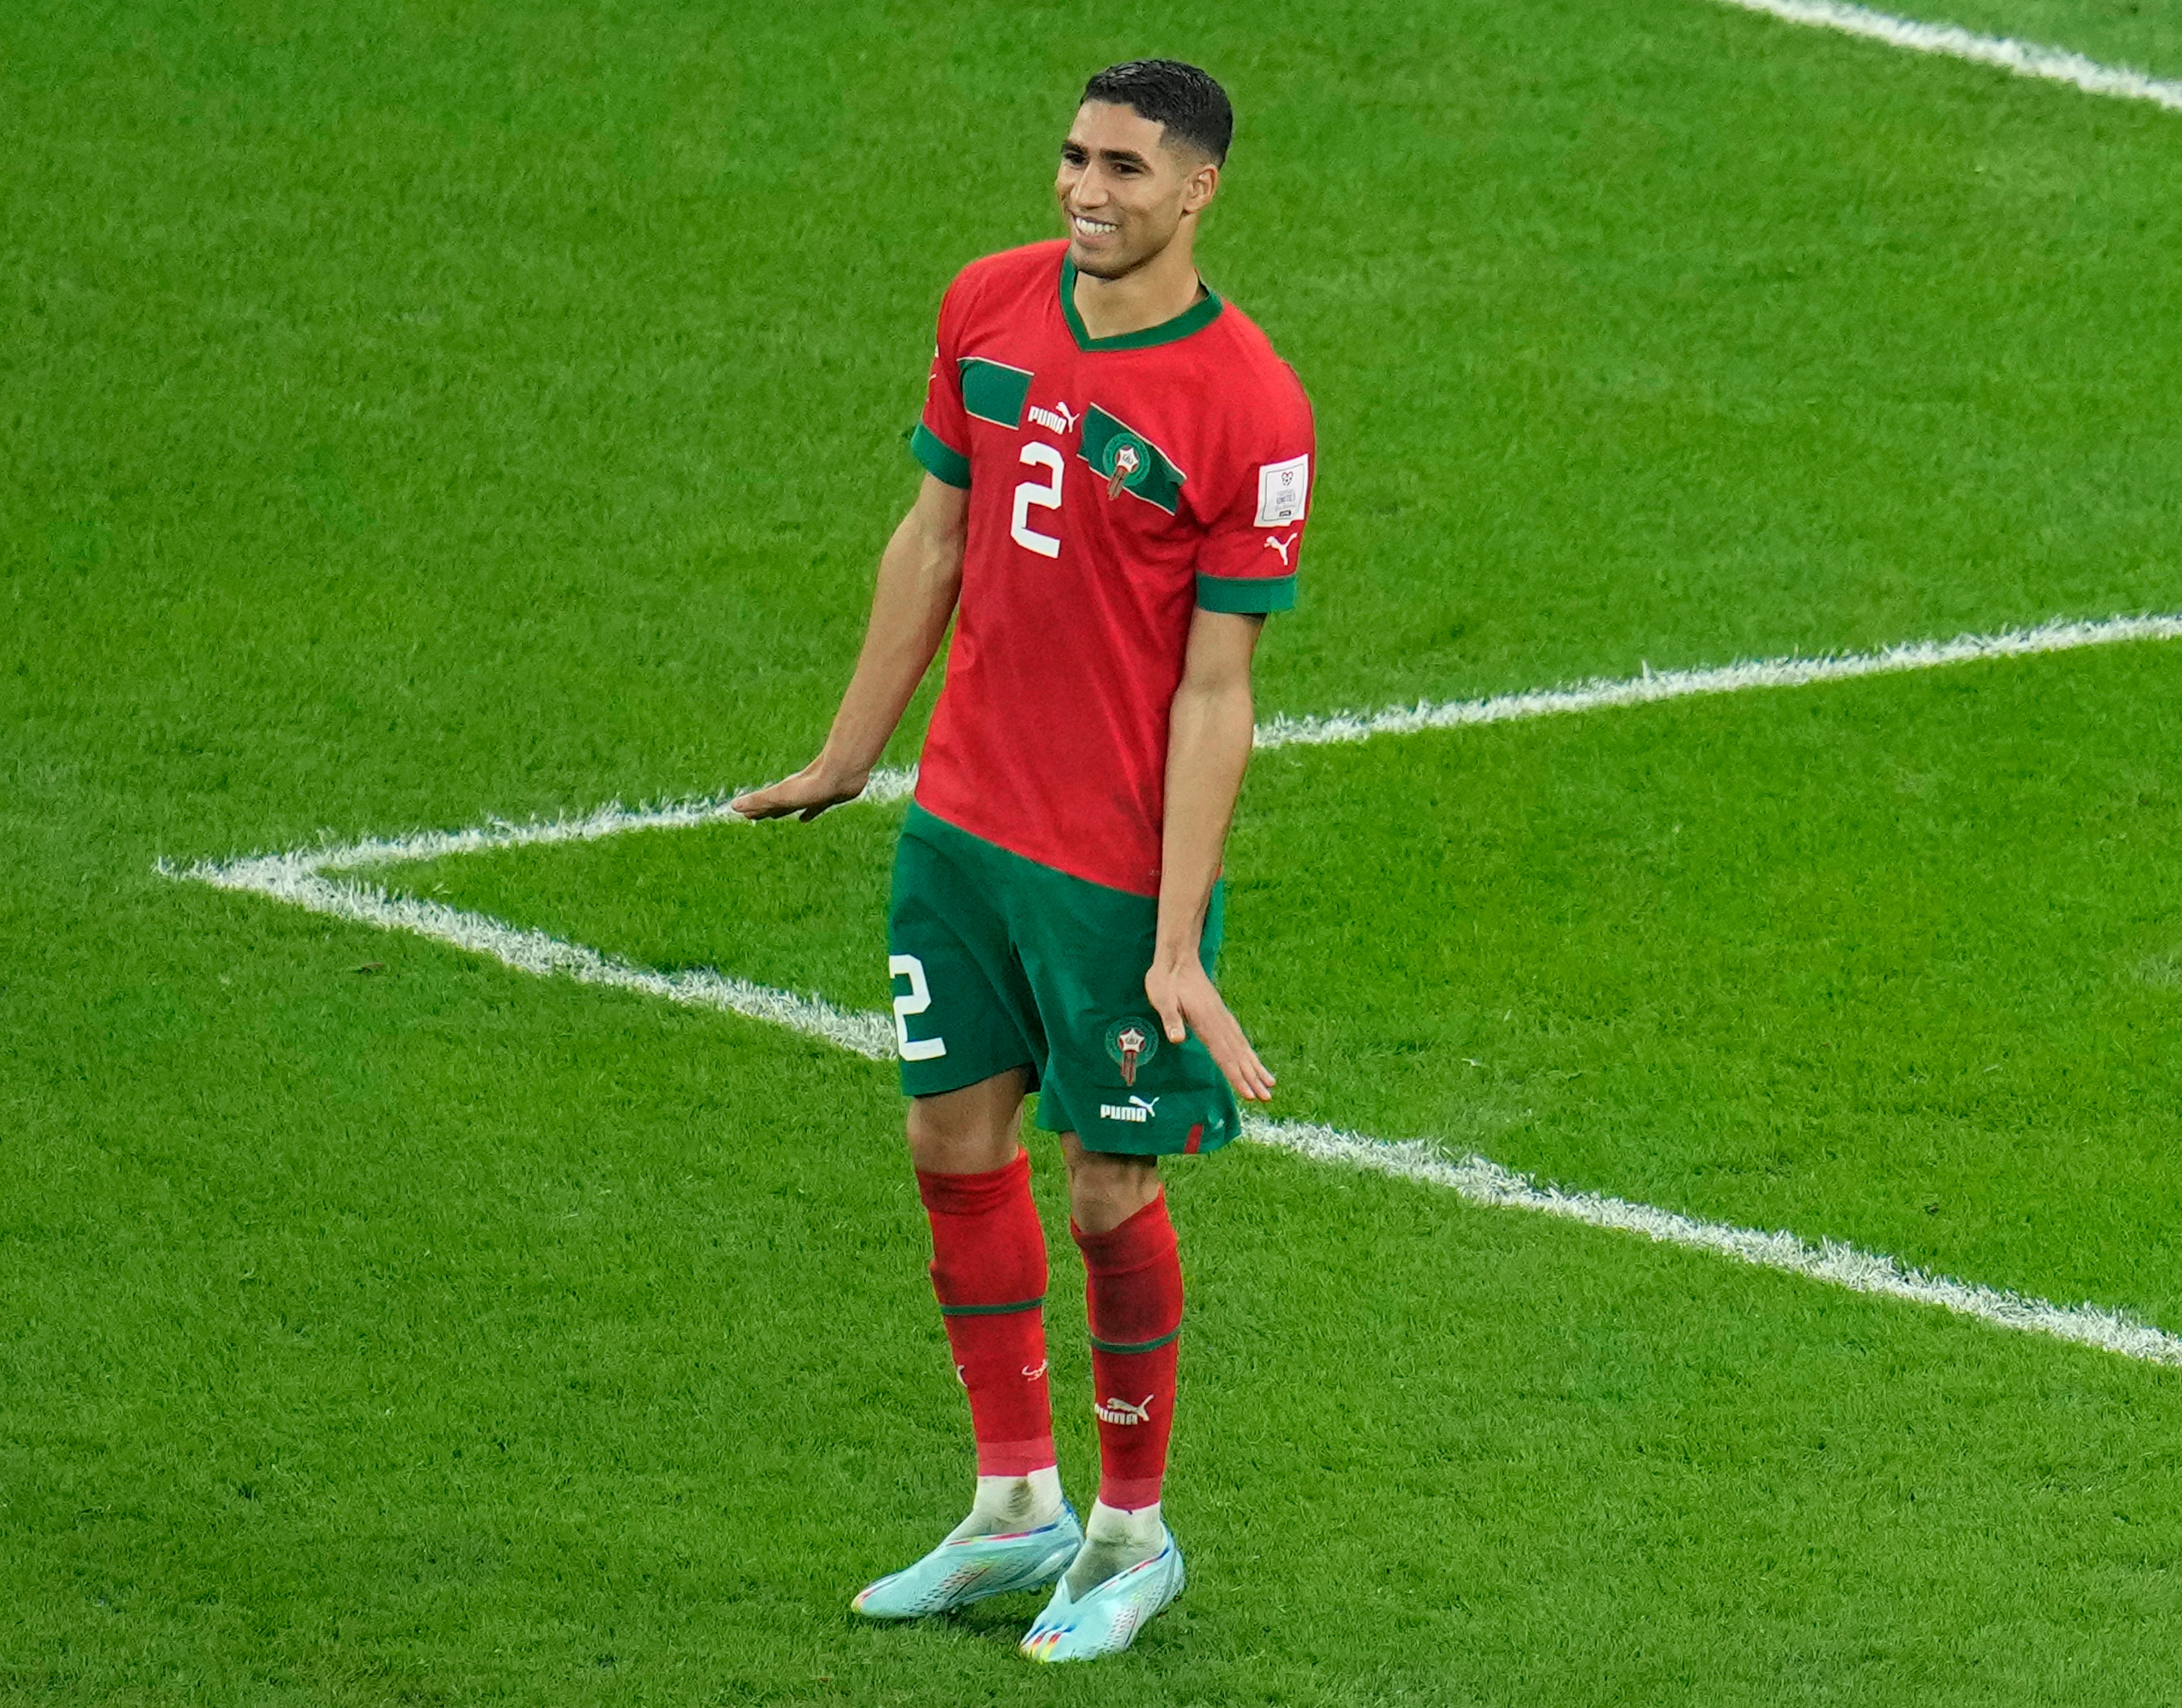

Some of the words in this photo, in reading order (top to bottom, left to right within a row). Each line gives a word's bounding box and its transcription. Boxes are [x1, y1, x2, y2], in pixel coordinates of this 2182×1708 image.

[1028, 406, 1067, 435] PUMA
[1011, 441, 1064, 559] 2
[889, 954, 946, 1061] 2
[1100, 1104, 1146, 1122] PUMA
